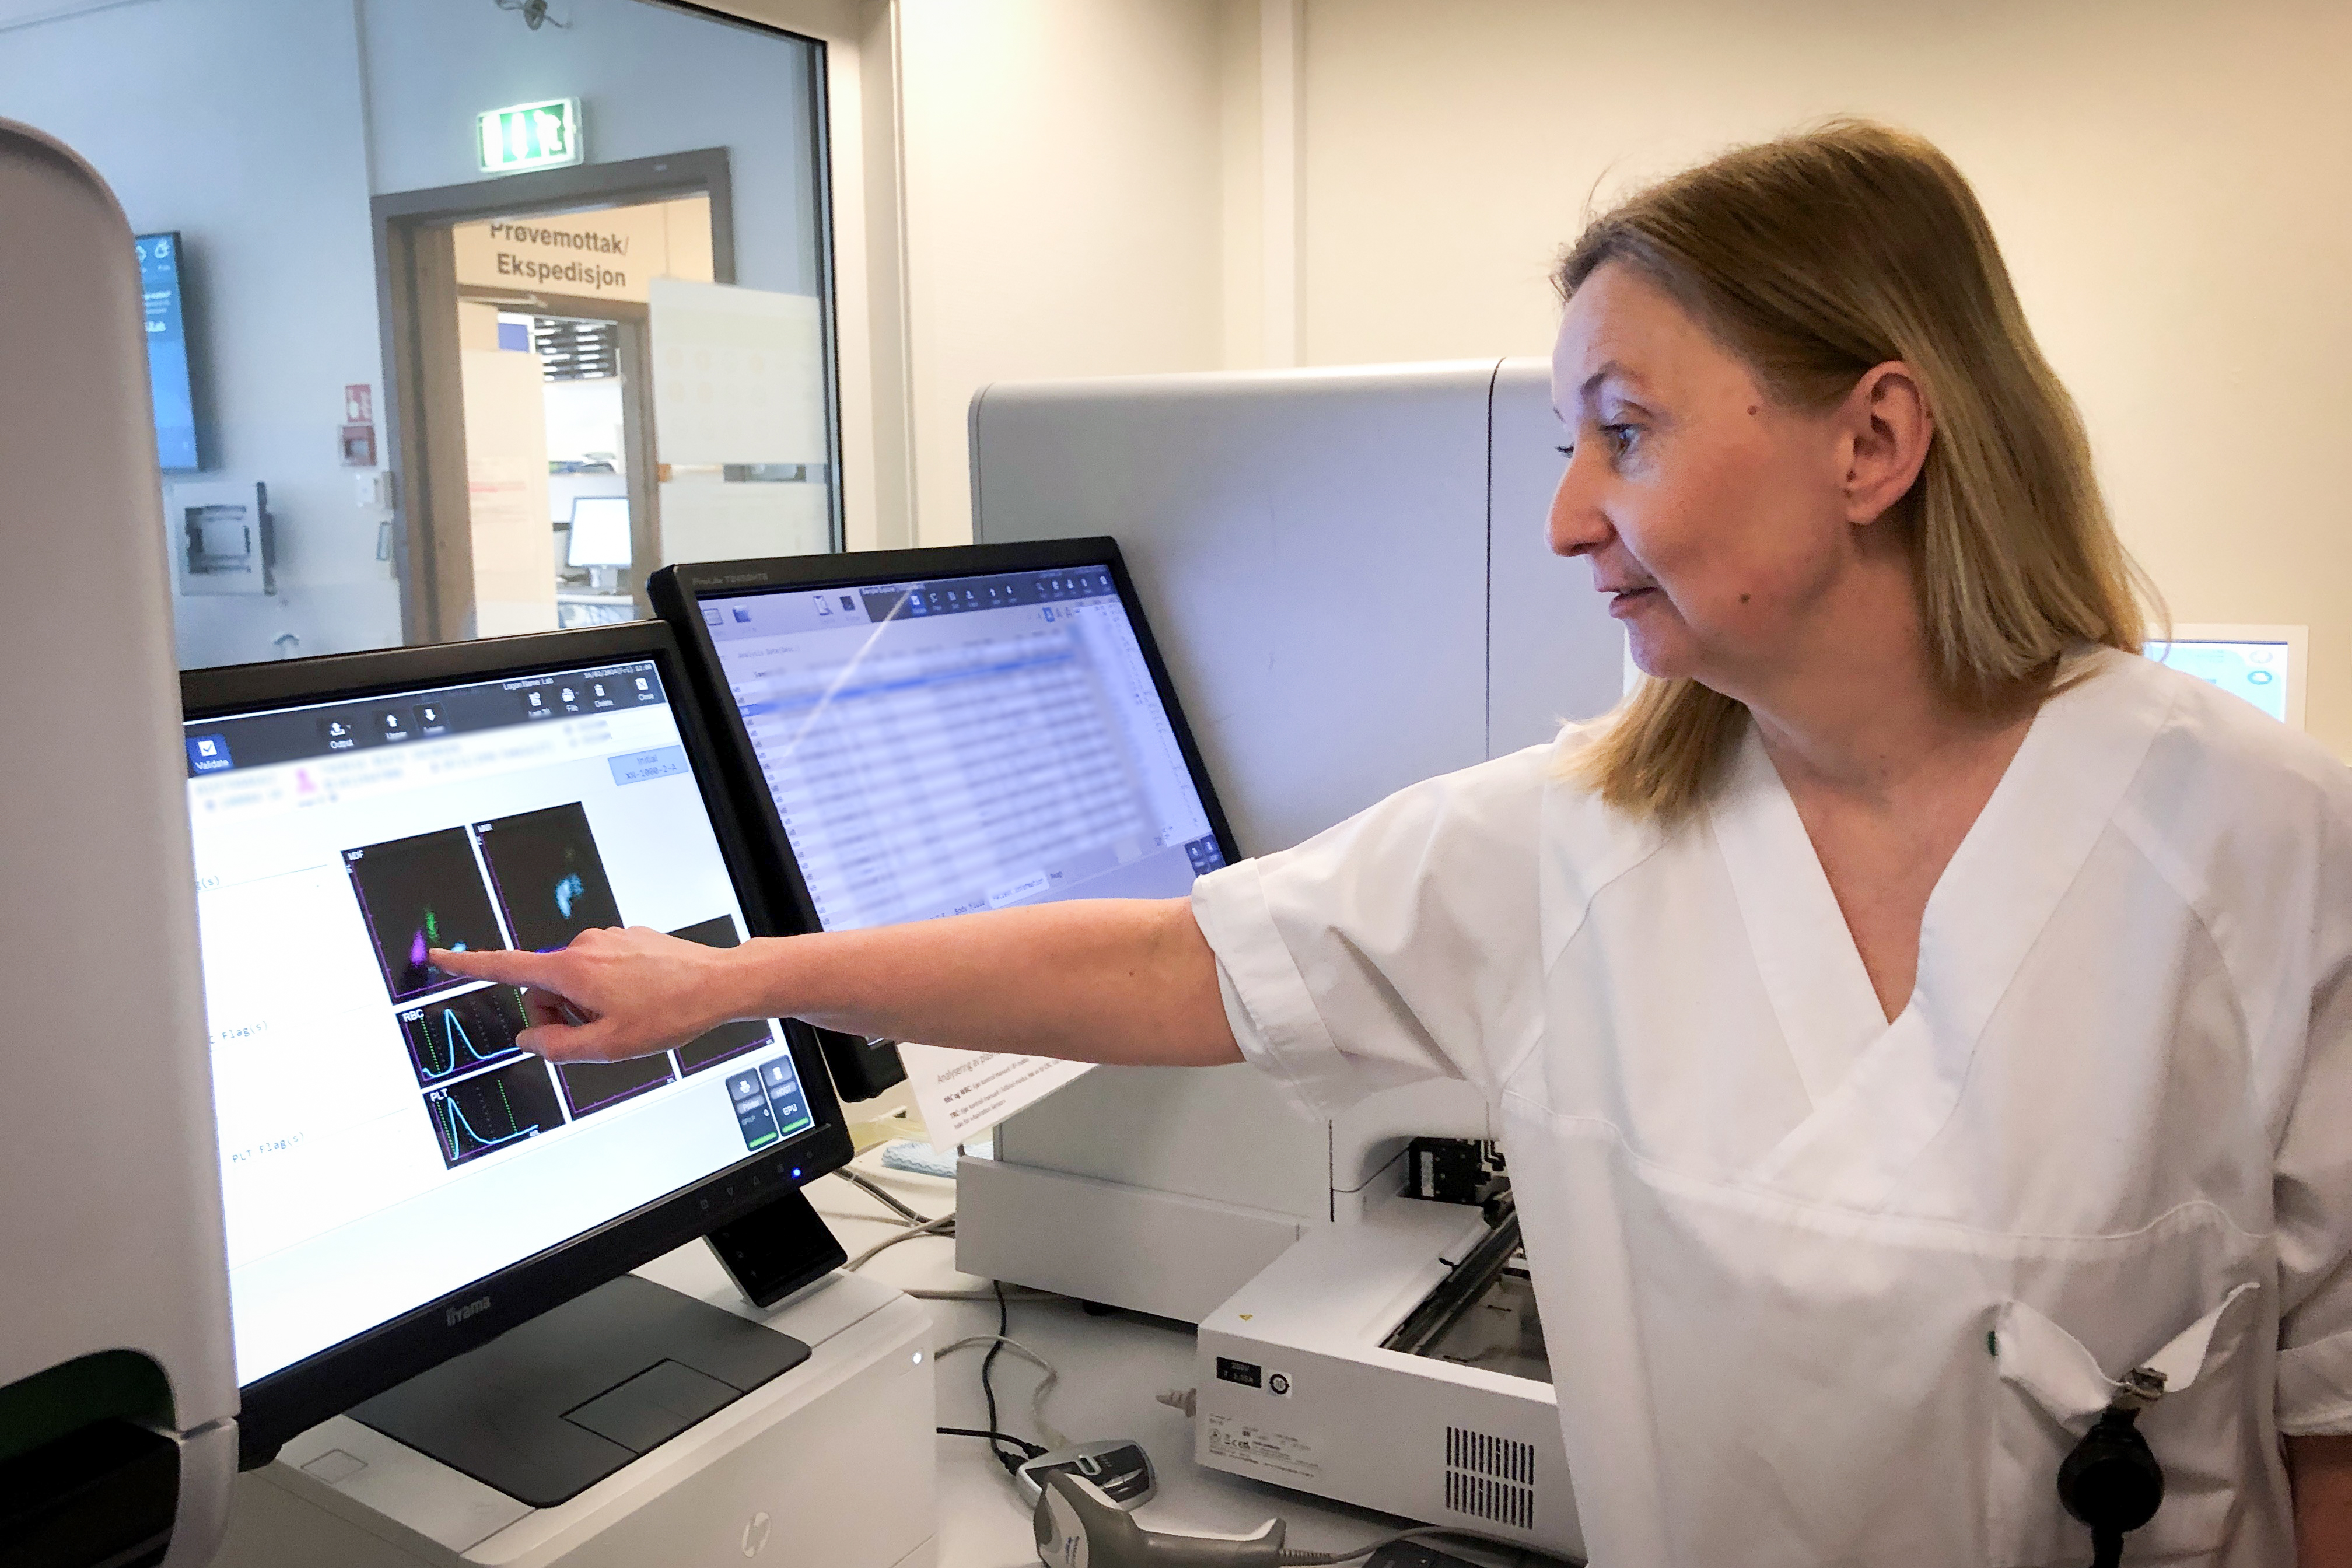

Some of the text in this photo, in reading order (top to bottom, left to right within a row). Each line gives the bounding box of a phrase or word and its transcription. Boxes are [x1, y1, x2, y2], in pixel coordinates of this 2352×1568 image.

[496, 252, 626, 290] Ekspedisjon
[195, 758, 229, 771] Validate
[402, 1009, 425, 1023] RBC
[222, 1020, 268, 1041] Flag(s)
[430, 1088, 448, 1103] PLT
[776, 1085, 792, 1097] HOST
[782, 1104, 797, 1116] EPU
[232, 1132, 304, 1164] PLT Flag(s)
